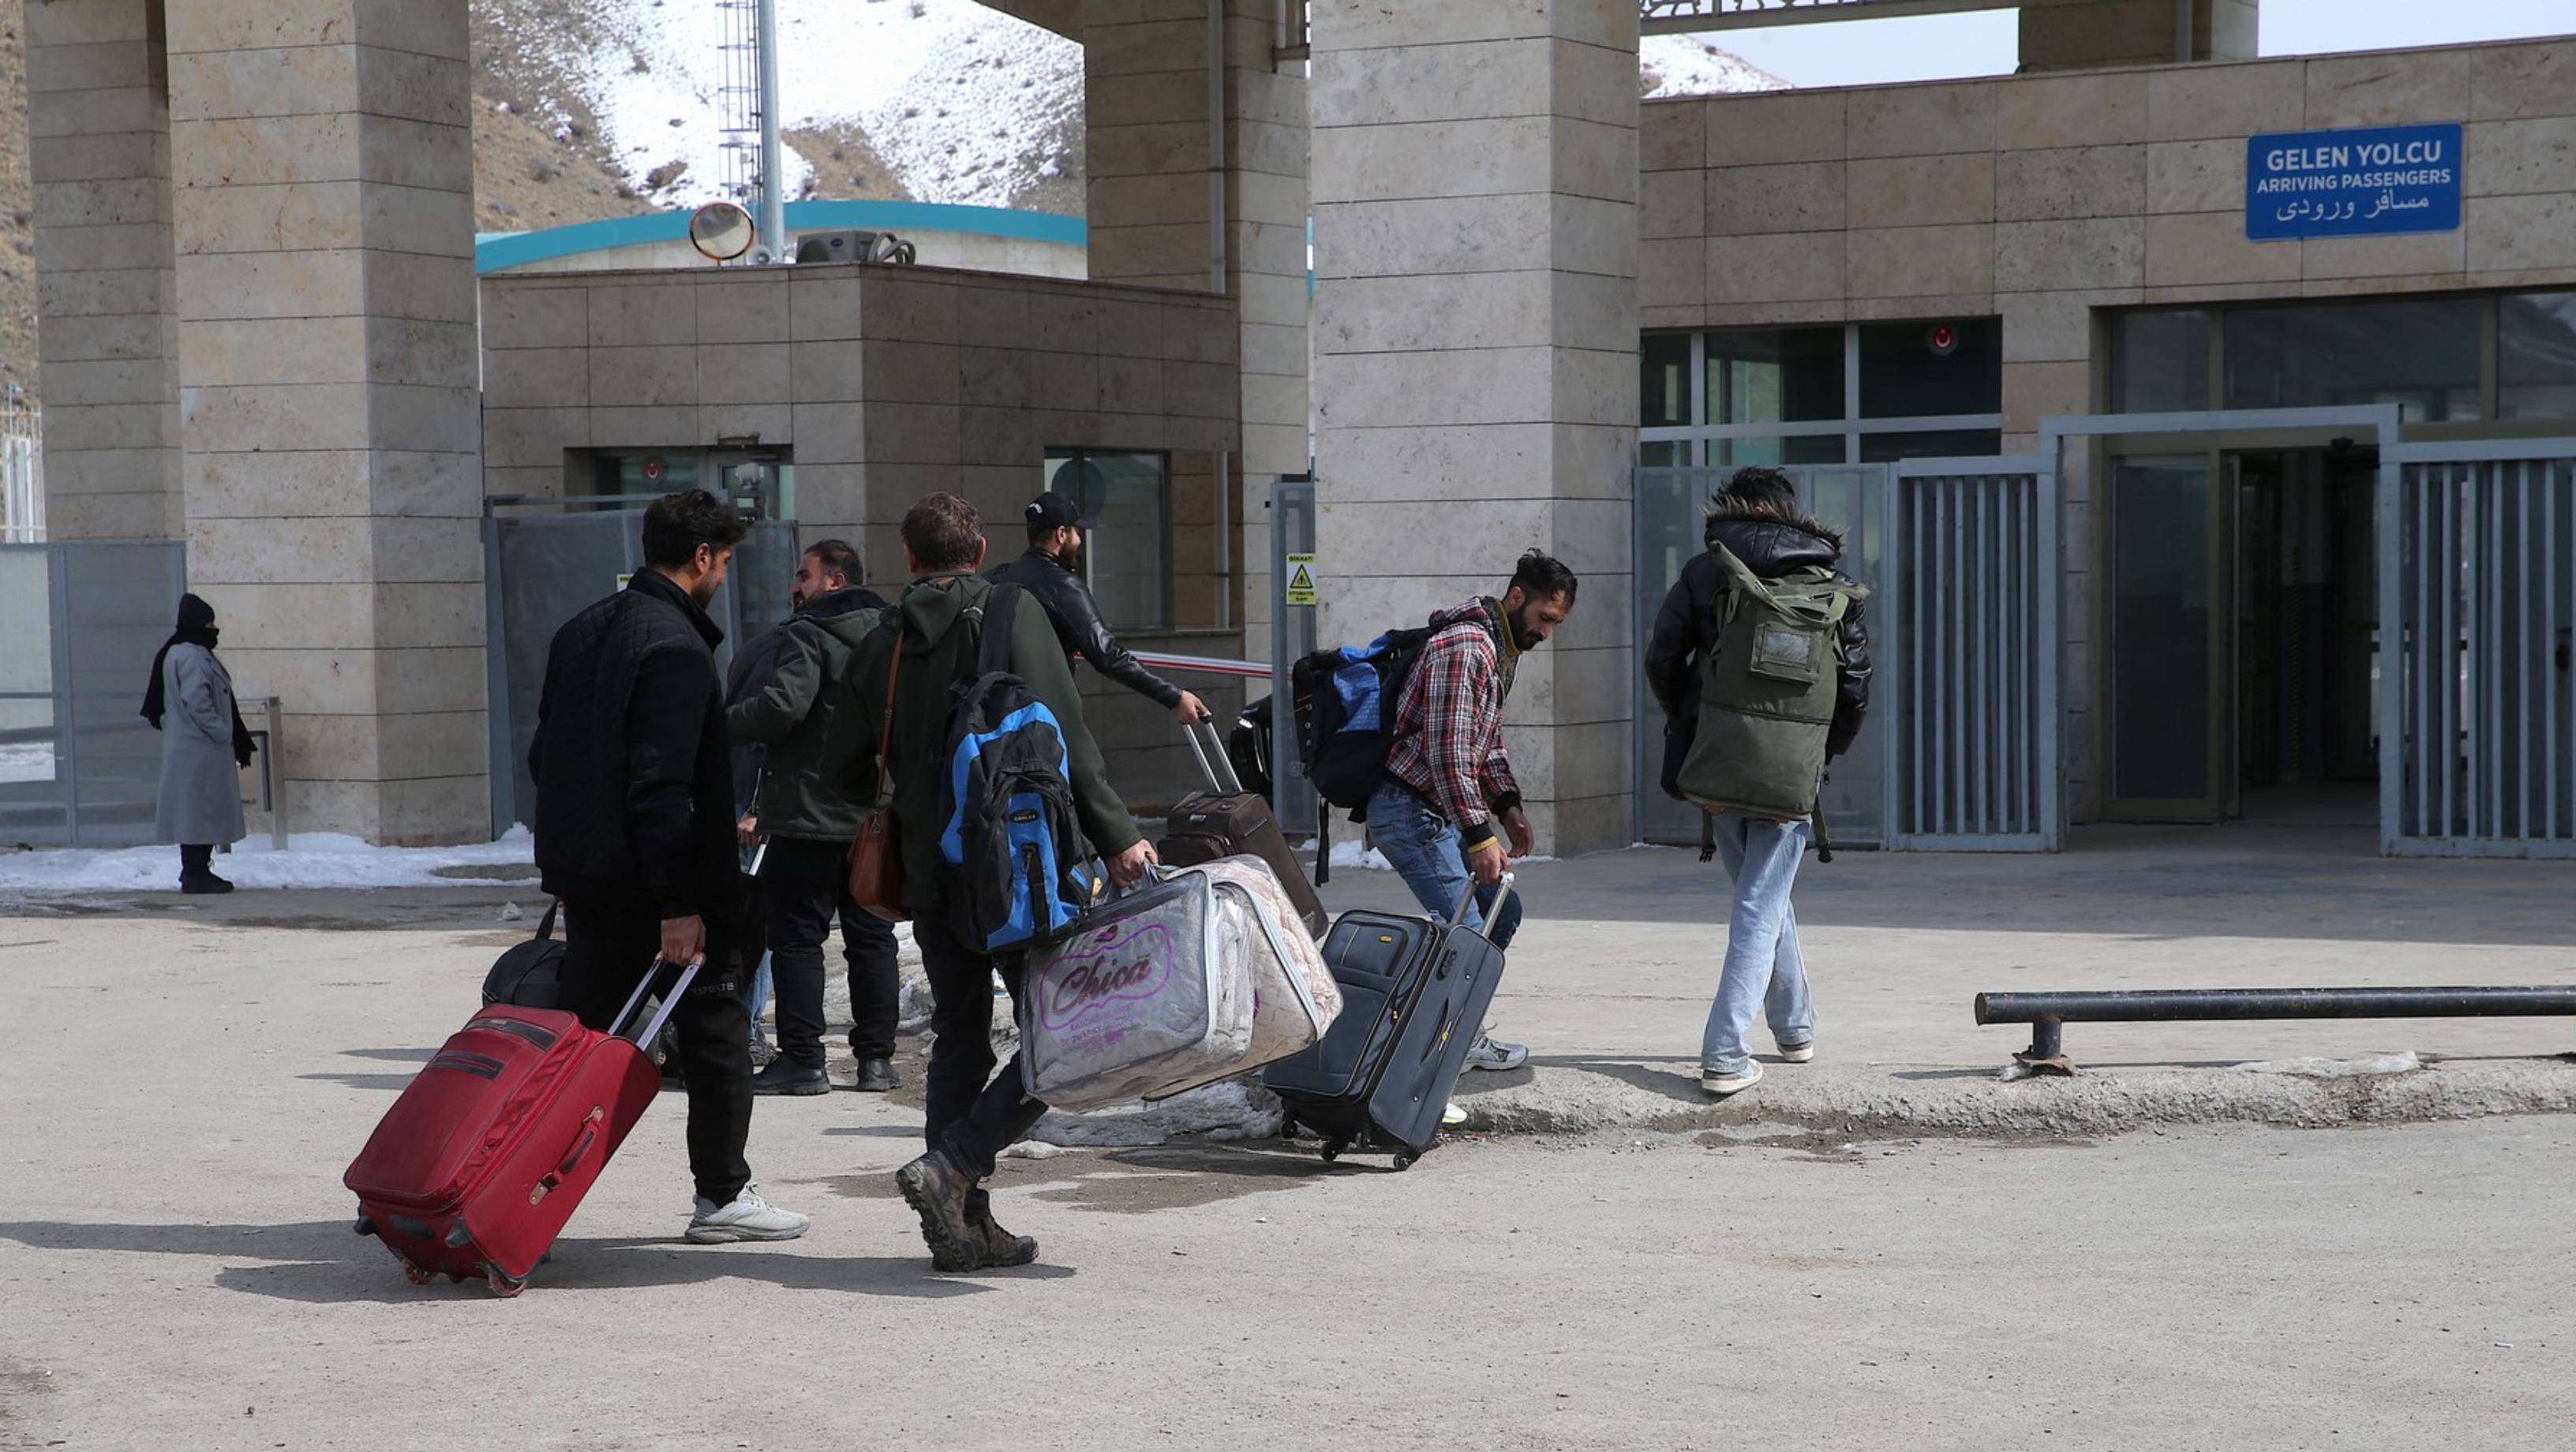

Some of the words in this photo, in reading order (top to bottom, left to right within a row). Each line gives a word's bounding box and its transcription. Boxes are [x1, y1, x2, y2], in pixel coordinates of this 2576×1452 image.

[2267, 146, 2349, 171] GELEN
[2357, 140, 2442, 167] YOLCU
[2257, 174, 2337, 193] ARRIVING
[2342, 169, 2451, 189] PASSENGERS
[2276, 199, 2355, 221] ورودی
[2364, 189, 2429, 218] مسافر
